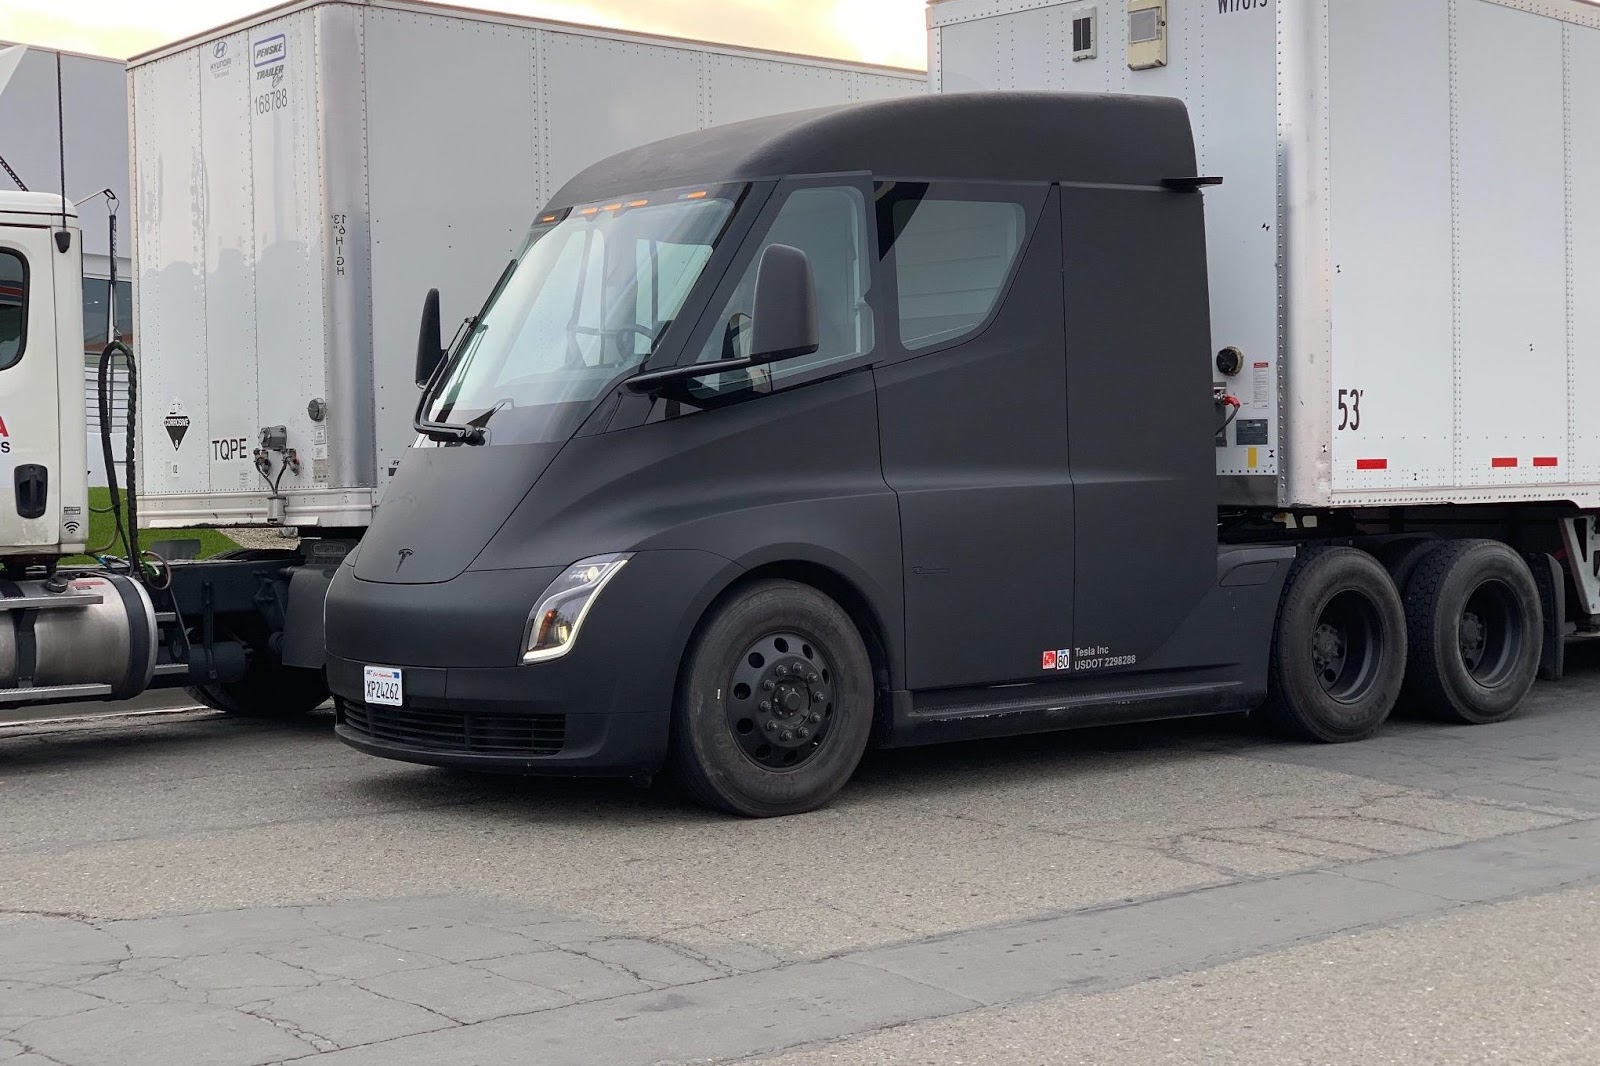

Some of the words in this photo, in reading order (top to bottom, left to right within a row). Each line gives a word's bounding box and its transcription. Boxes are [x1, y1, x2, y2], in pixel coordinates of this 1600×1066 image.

[256, 43, 283, 59] PENSKE
[256, 64, 285, 80] TRAILER
[254, 88, 288, 116] 168788
[1338, 388, 1364, 431] 53'
[212, 438, 247, 461] TQPE
[1074, 647, 1095, 657] Tesla
[1097, 645, 1109, 655] Inc
[1058, 654, 1069, 668] 80
[1074, 658, 1102, 670] USDOT
[366, 680, 399, 700] XP24262
